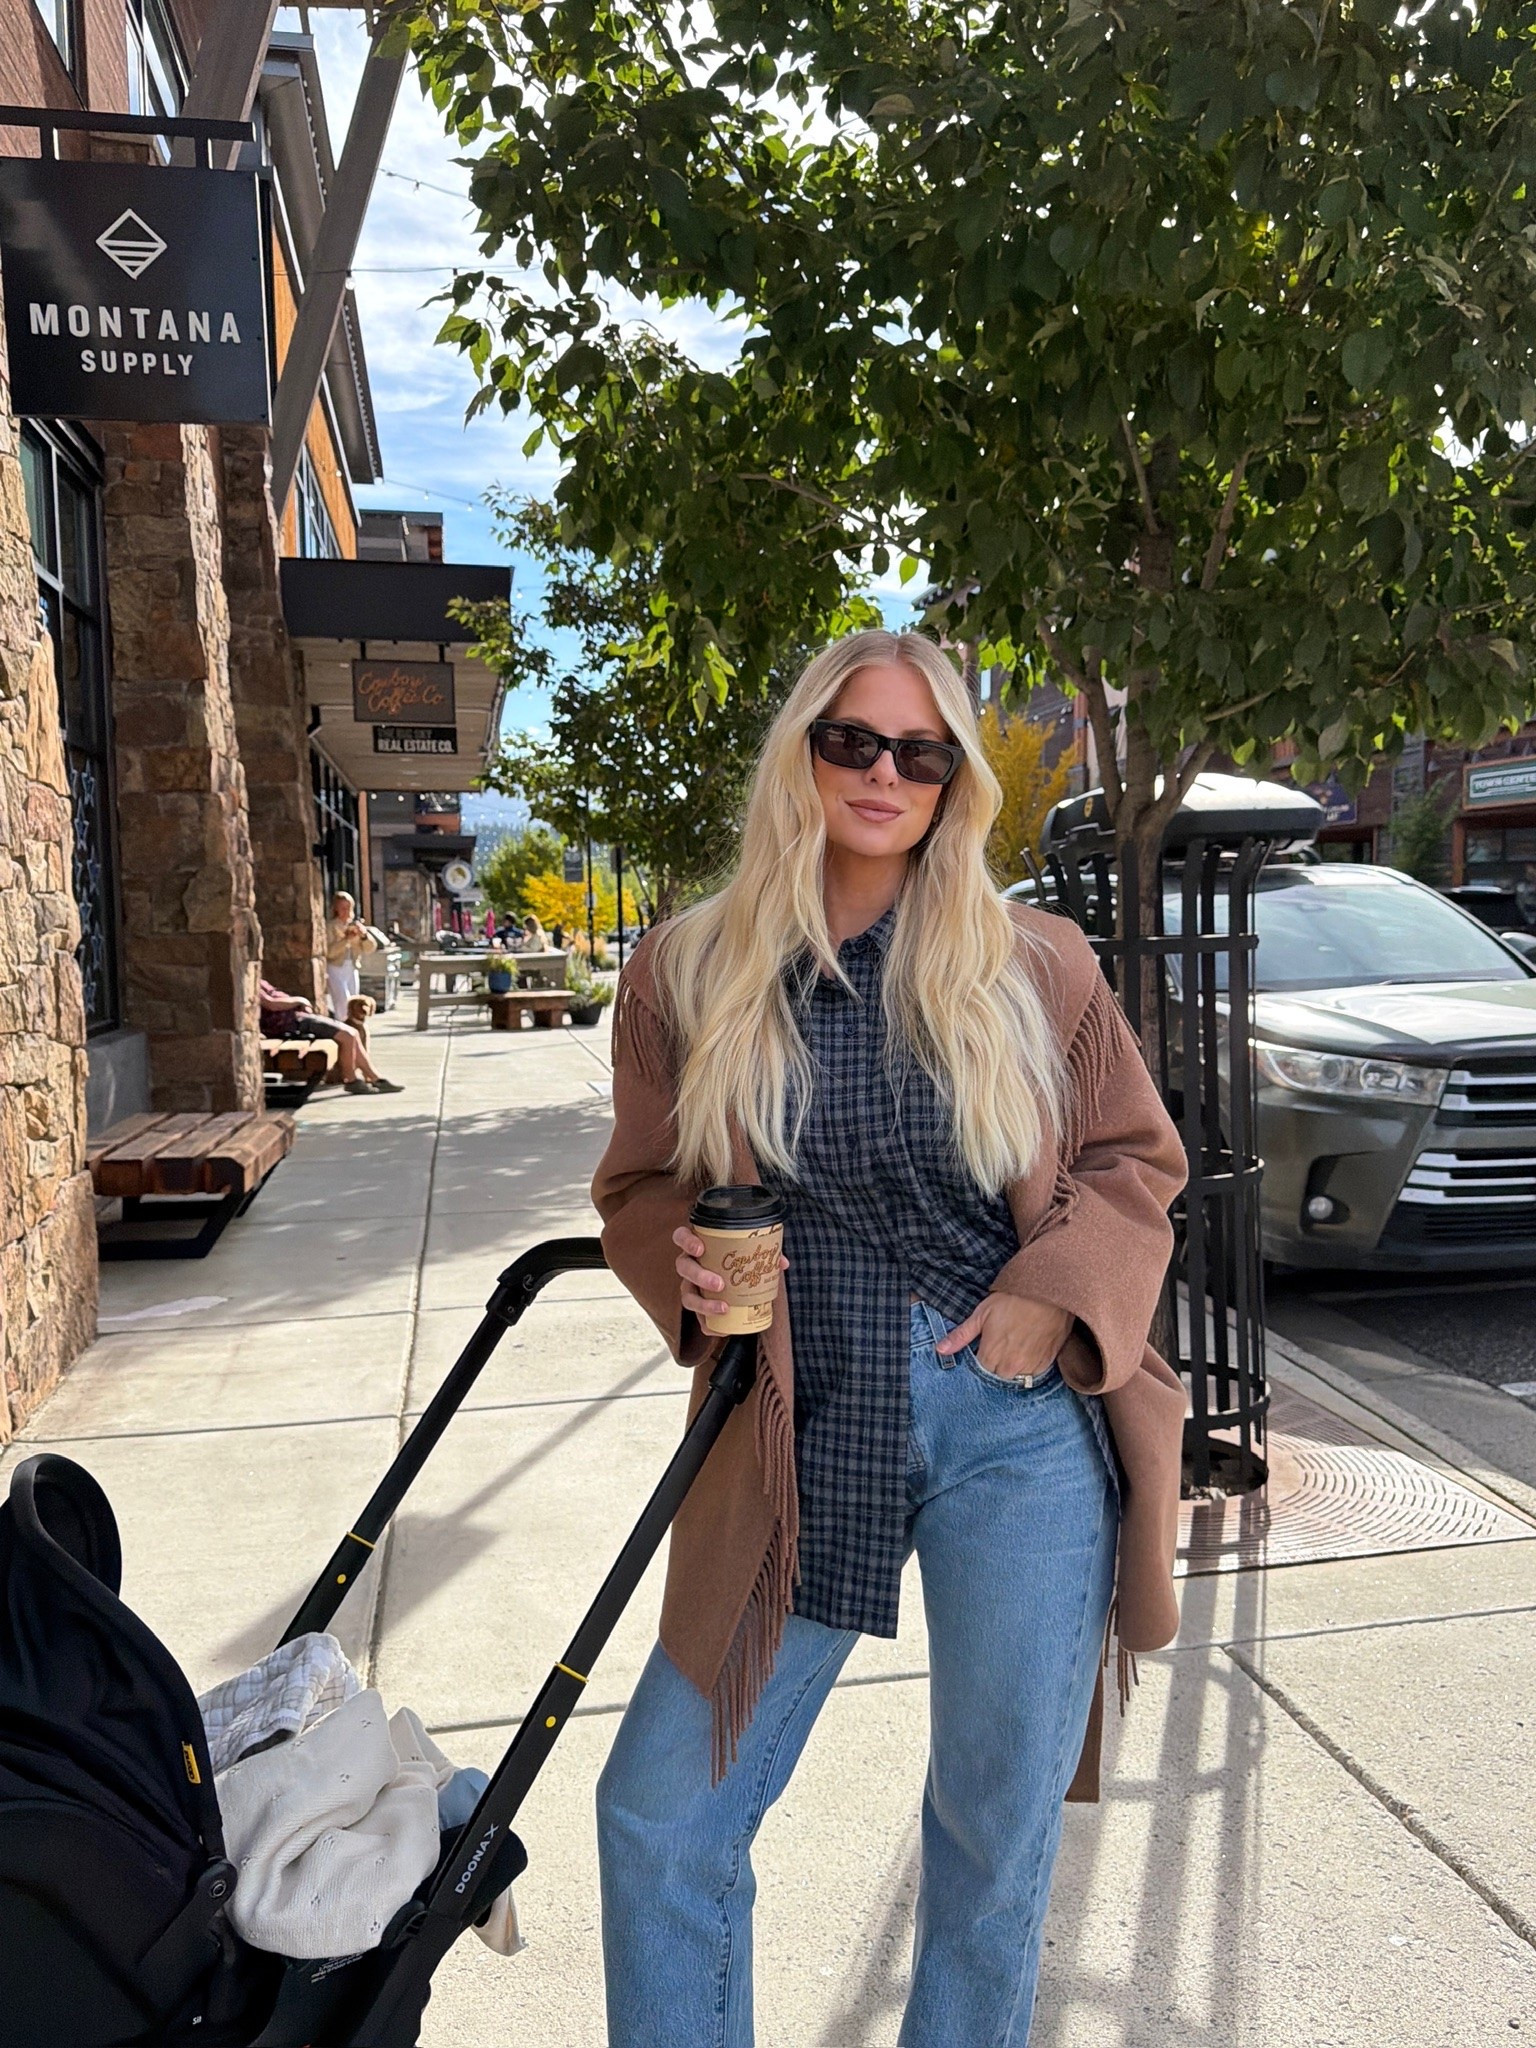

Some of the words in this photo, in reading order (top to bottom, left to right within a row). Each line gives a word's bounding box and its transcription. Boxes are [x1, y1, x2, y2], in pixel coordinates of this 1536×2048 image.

[29, 303, 241, 344] MONTANA
[80, 350, 193, 376] SUPPLY
[378, 739, 402, 752] REAL
[404, 739, 437, 752] ESTATE
